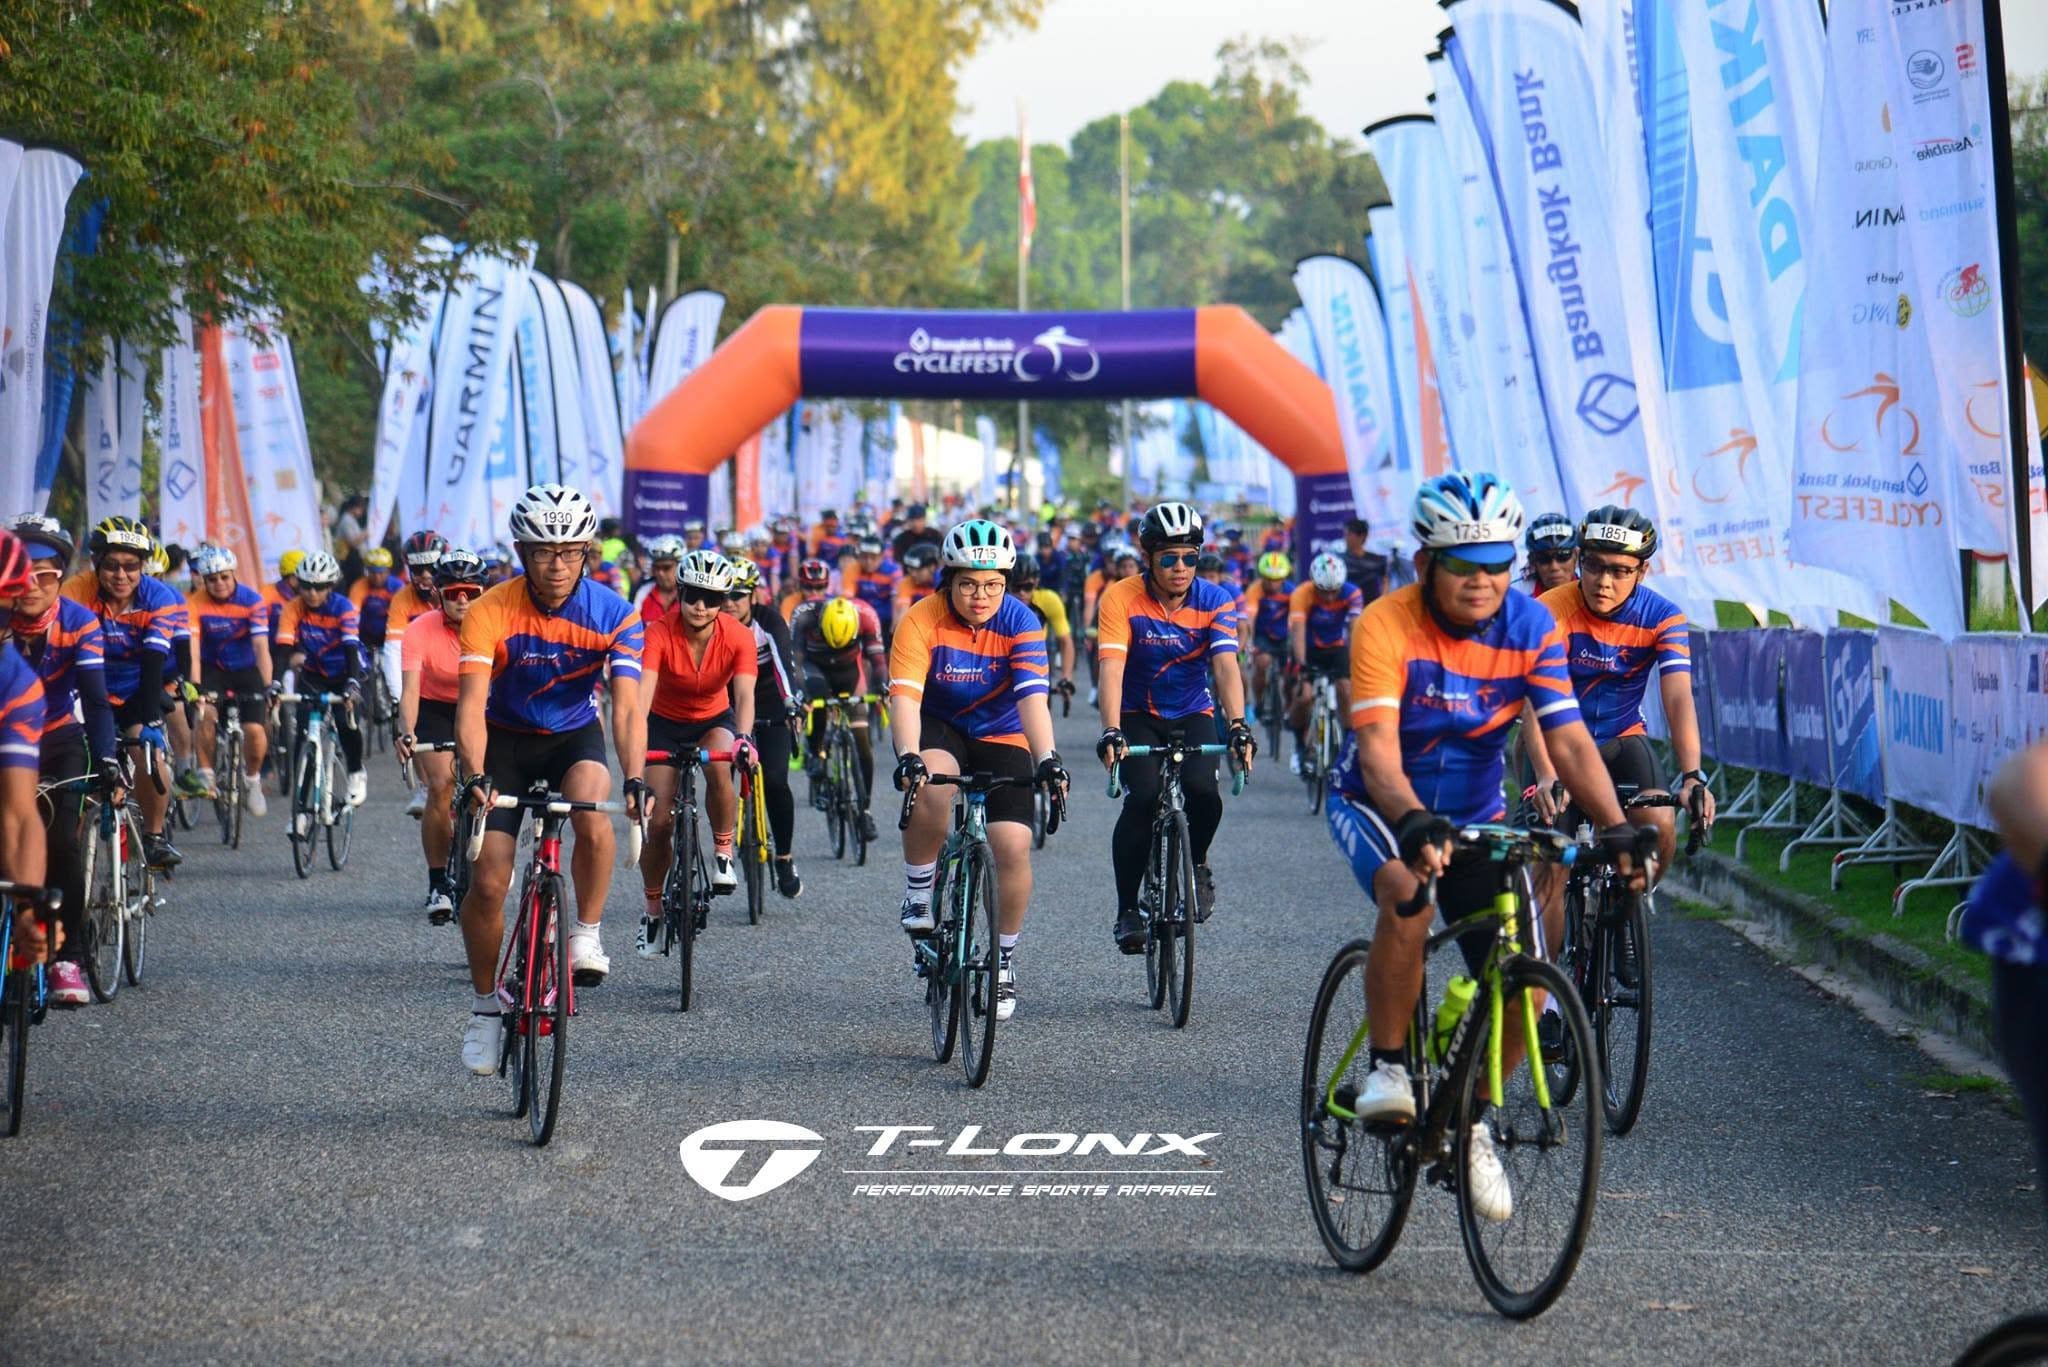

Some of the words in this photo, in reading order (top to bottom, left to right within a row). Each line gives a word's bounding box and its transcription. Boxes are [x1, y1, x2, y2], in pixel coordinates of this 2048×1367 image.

[893, 352, 1014, 374] CYCLEFEST
[447, 285, 503, 487] GARMIN
[543, 511, 573, 524] 1930
[1453, 523, 1492, 541] 1735
[1600, 525, 1628, 541] 1851
[972, 547, 997, 560] 1715
[693, 571, 715, 586] 1941
[1891, 692, 1944, 755] DAIKIN
